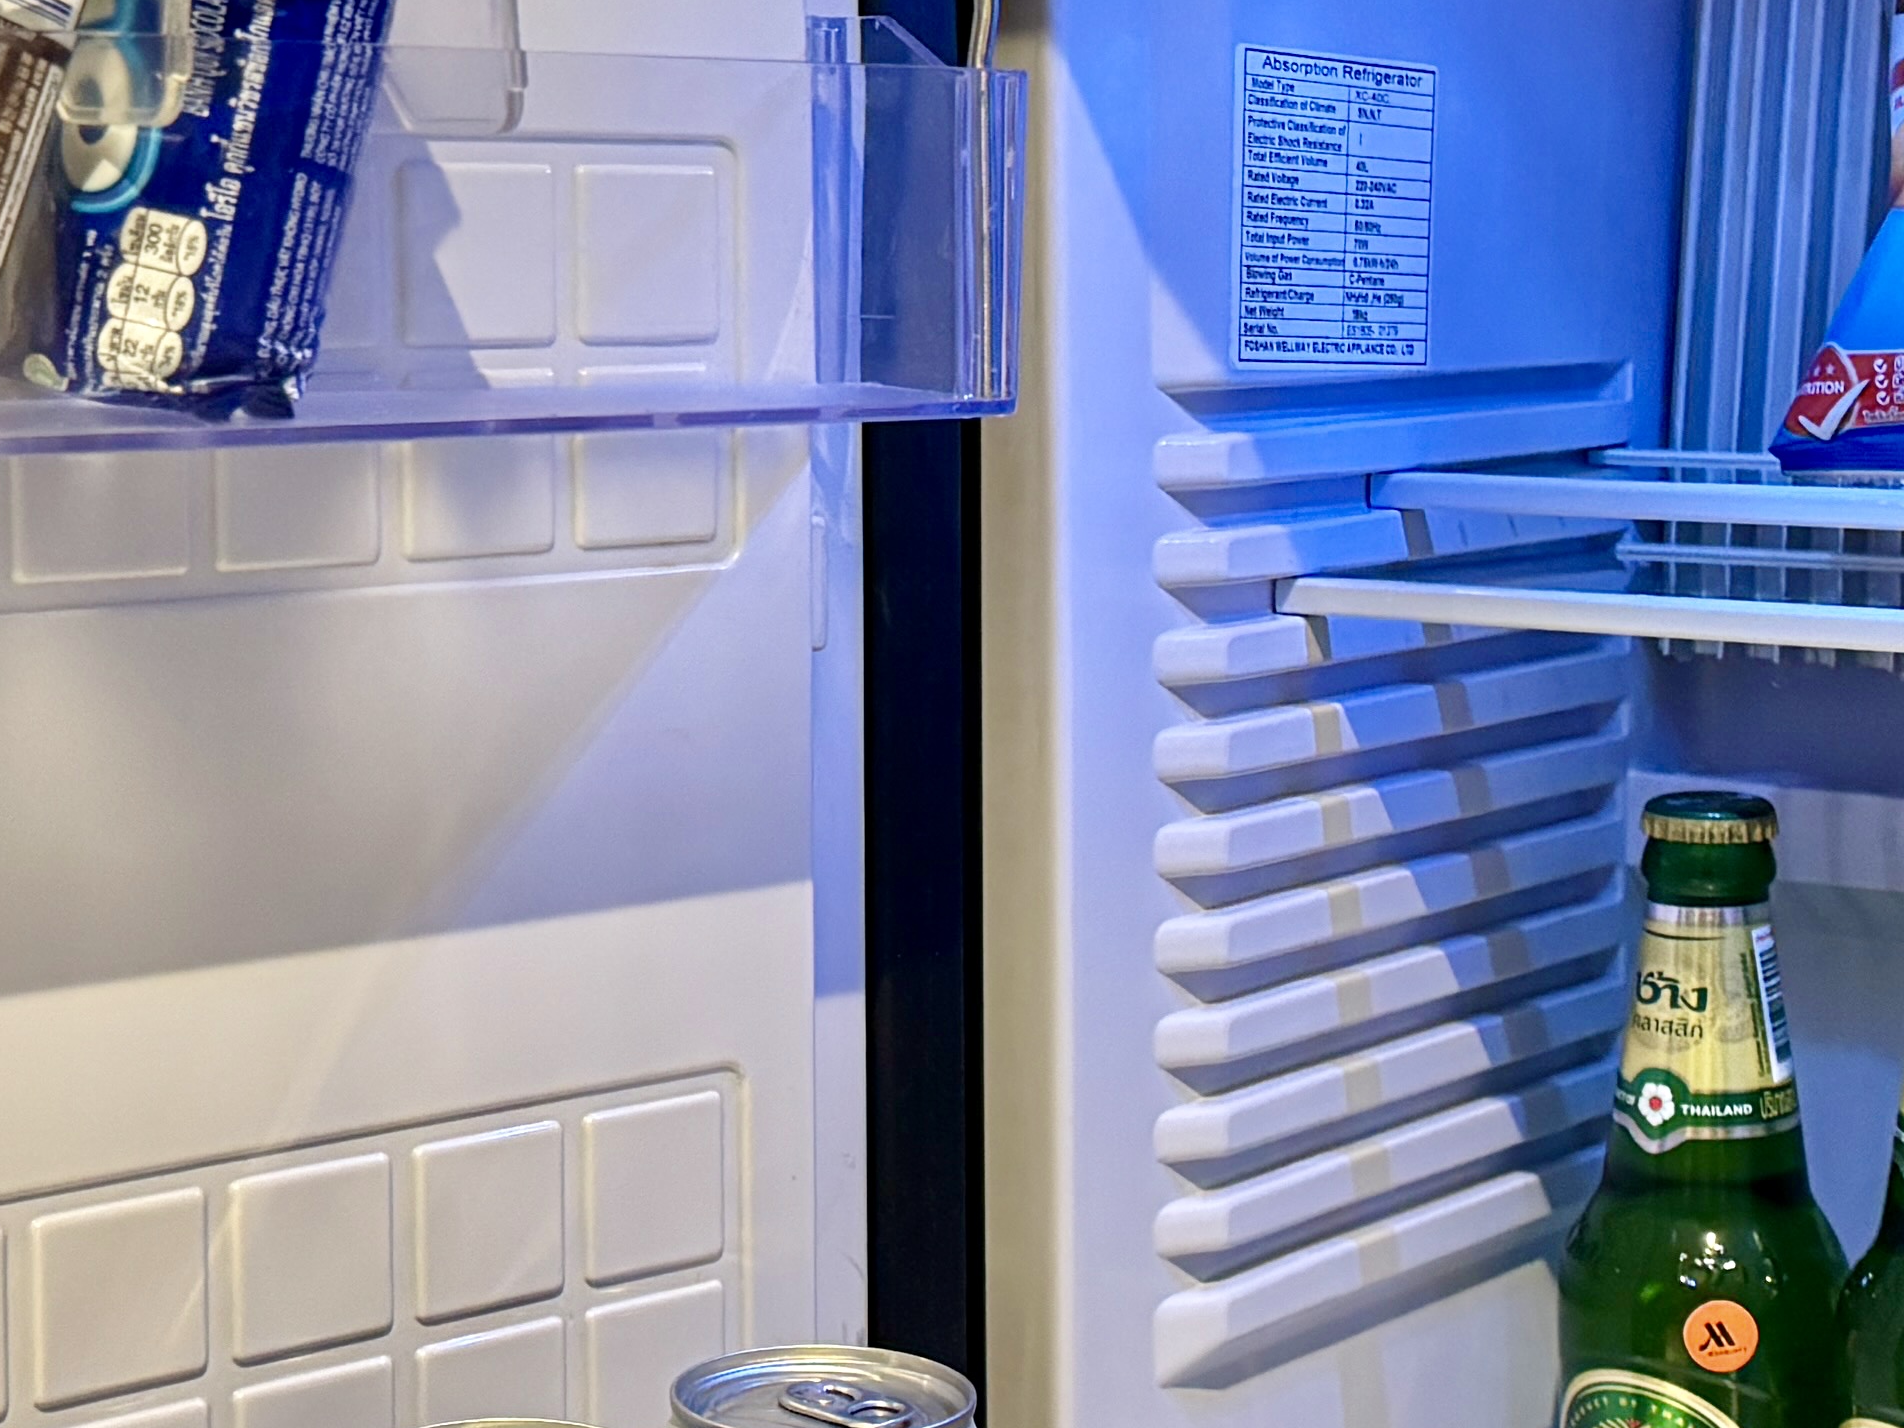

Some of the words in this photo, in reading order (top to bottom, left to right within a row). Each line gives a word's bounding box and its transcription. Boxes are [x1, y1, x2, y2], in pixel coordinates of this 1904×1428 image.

[1263, 56, 1338, 77] Absorption
[1343, 66, 1423, 87] Refrigerator
[1680, 1104, 1753, 1117] THAILAND
